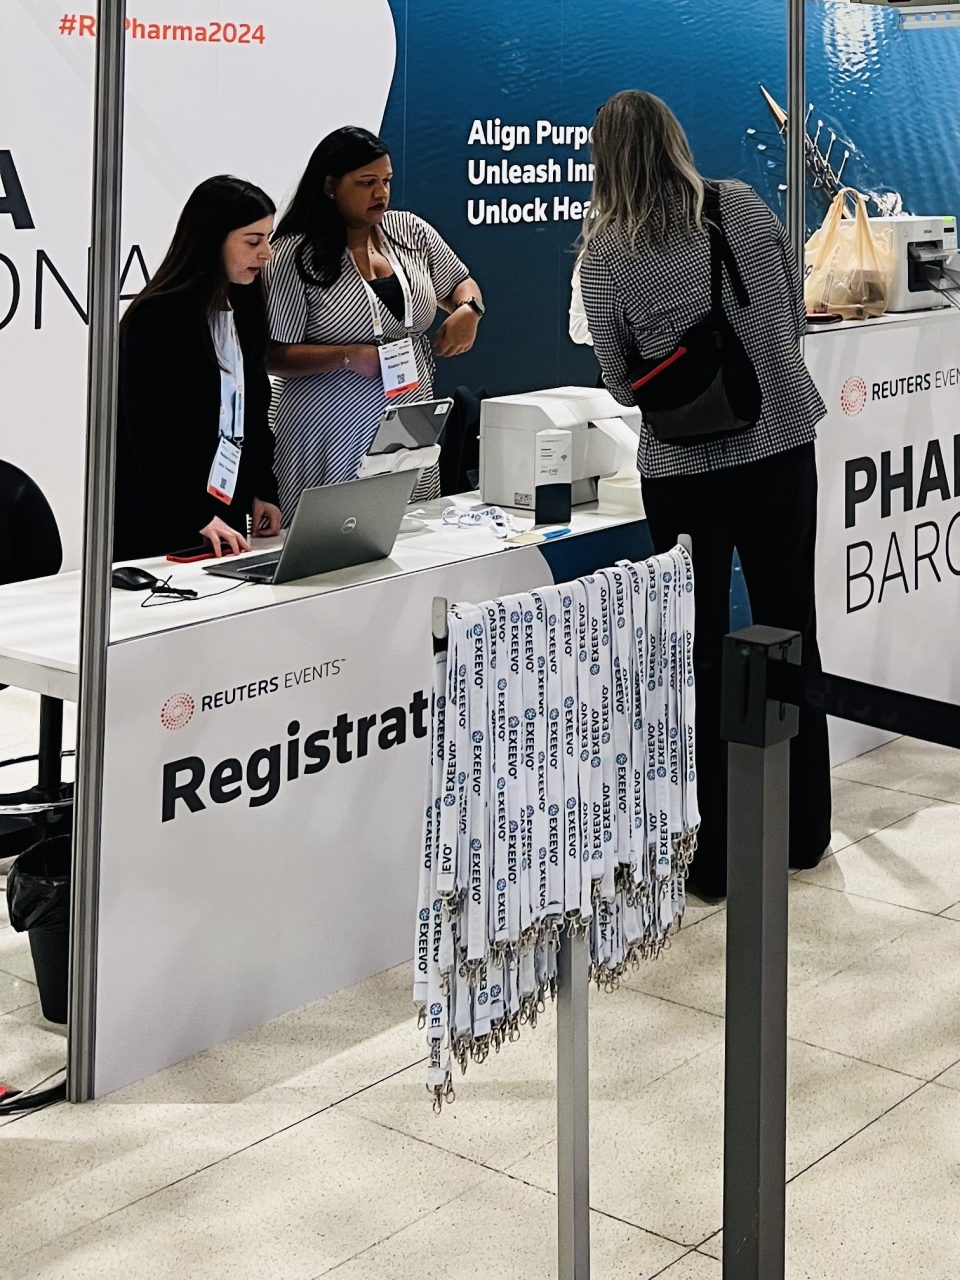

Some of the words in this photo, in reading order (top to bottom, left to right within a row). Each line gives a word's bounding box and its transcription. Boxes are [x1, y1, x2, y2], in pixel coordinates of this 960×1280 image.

[468, 118, 531, 152] Align
[468, 158, 561, 186] Unleash
[467, 197, 548, 226] Unlock
[872, 373, 931, 401] REUTERS
[201, 676, 280, 713] REUTERS
